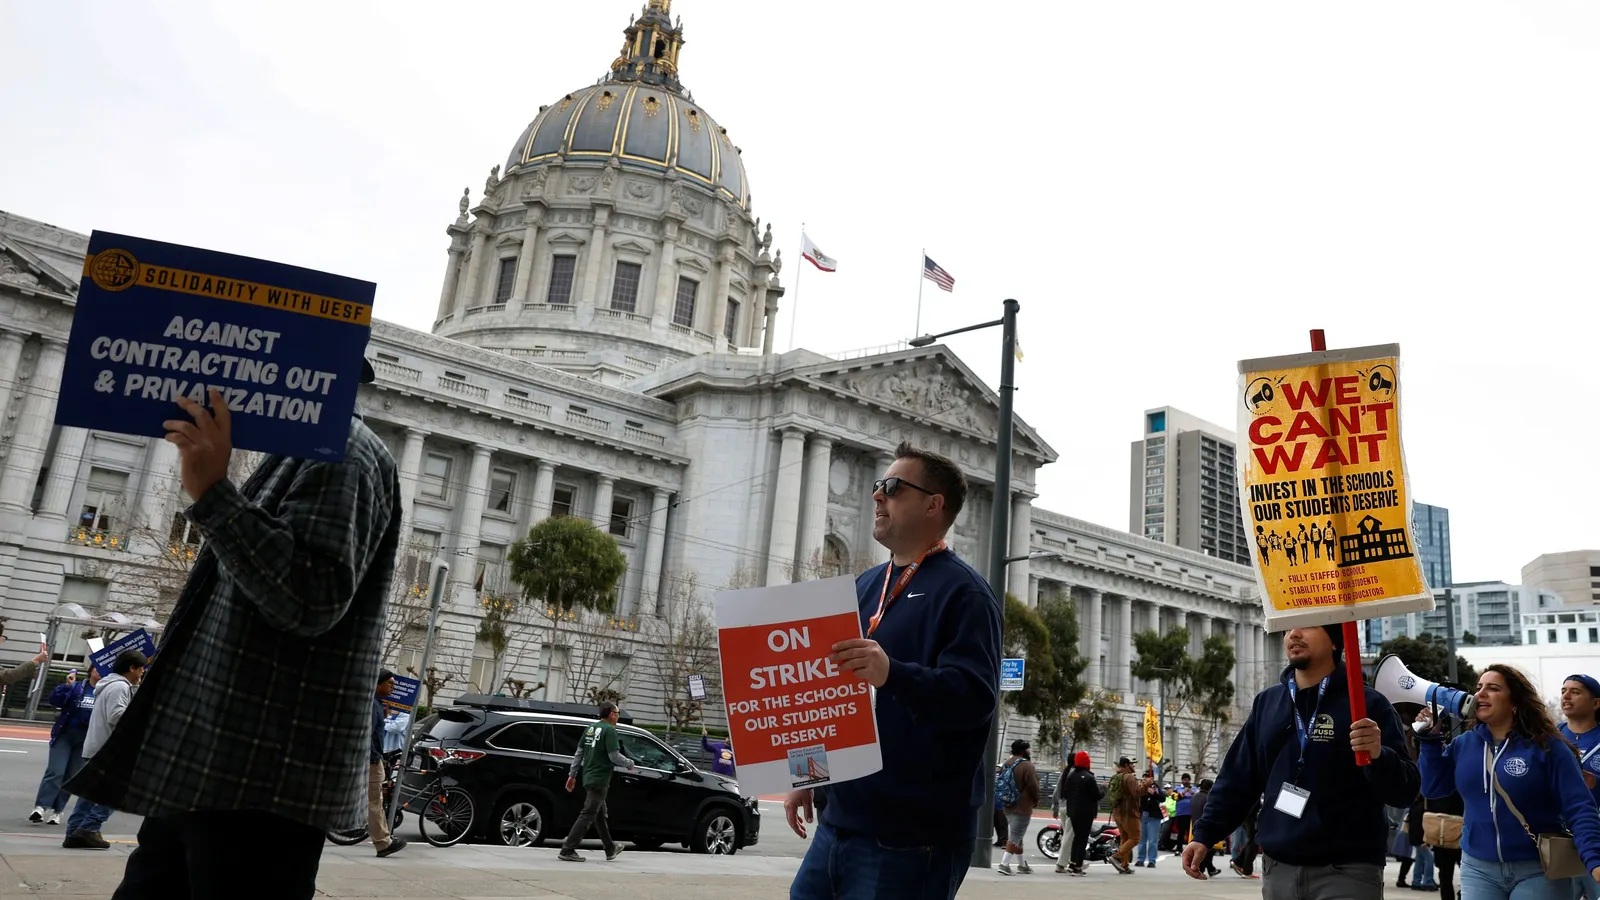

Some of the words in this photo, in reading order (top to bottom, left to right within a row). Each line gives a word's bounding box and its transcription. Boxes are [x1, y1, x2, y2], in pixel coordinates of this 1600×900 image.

[145, 268, 258, 300] SOLIDARITY
[268, 289, 311, 310] WITH
[320, 297, 364, 321] UESF
[163, 316, 280, 354] AGAINST
[90, 336, 278, 385] CONTRACTING
[285, 367, 336, 395] OUT
[94, 370, 116, 394] &
[1280, 376, 1361, 410] WE
[1248, 402, 1394, 445] CAN'T
[1253, 434, 1387, 475] WAIT
[1250, 480, 1297, 502] INVEST
[1302, 479, 1317, 497] IN
[1323, 476, 1344, 495] THE
[1346, 470, 1394, 492] SCHOOLS
[1254, 503, 1282, 522] OUR
[1286, 496, 1350, 519] STUDENTS
[1353, 489, 1399, 511] DESERVE
[1288, 573, 1308, 583] FULLY
[1310, 570, 1340, 581] STAFFED
[1342, 566, 1366, 579] SCHOOLS
[1289, 584, 1320, 596] STABILITY
[1322, 582, 1336, 592] FOR
[1338, 580, 1350, 590] OUR
[1351, 576, 1379, 588] STUDENTS
[1292, 597, 1313, 607] LIVING
[1315, 595, 1337, 605] WAGES
[1338, 593, 1351, 602] FOR
[1352, 587, 1384, 600] EDUCATORS
[767, 626, 811, 652] ON
[750, 656, 840, 689] STRIKE
[729, 698, 760, 715] FOR
[762, 694, 791, 710] THE
[795, 682, 867, 706] SCHOOLS
[745, 713, 779, 731] OUR
[782, 702, 857, 726] STUDENTS
[771, 725, 837, 746] DESERVE
